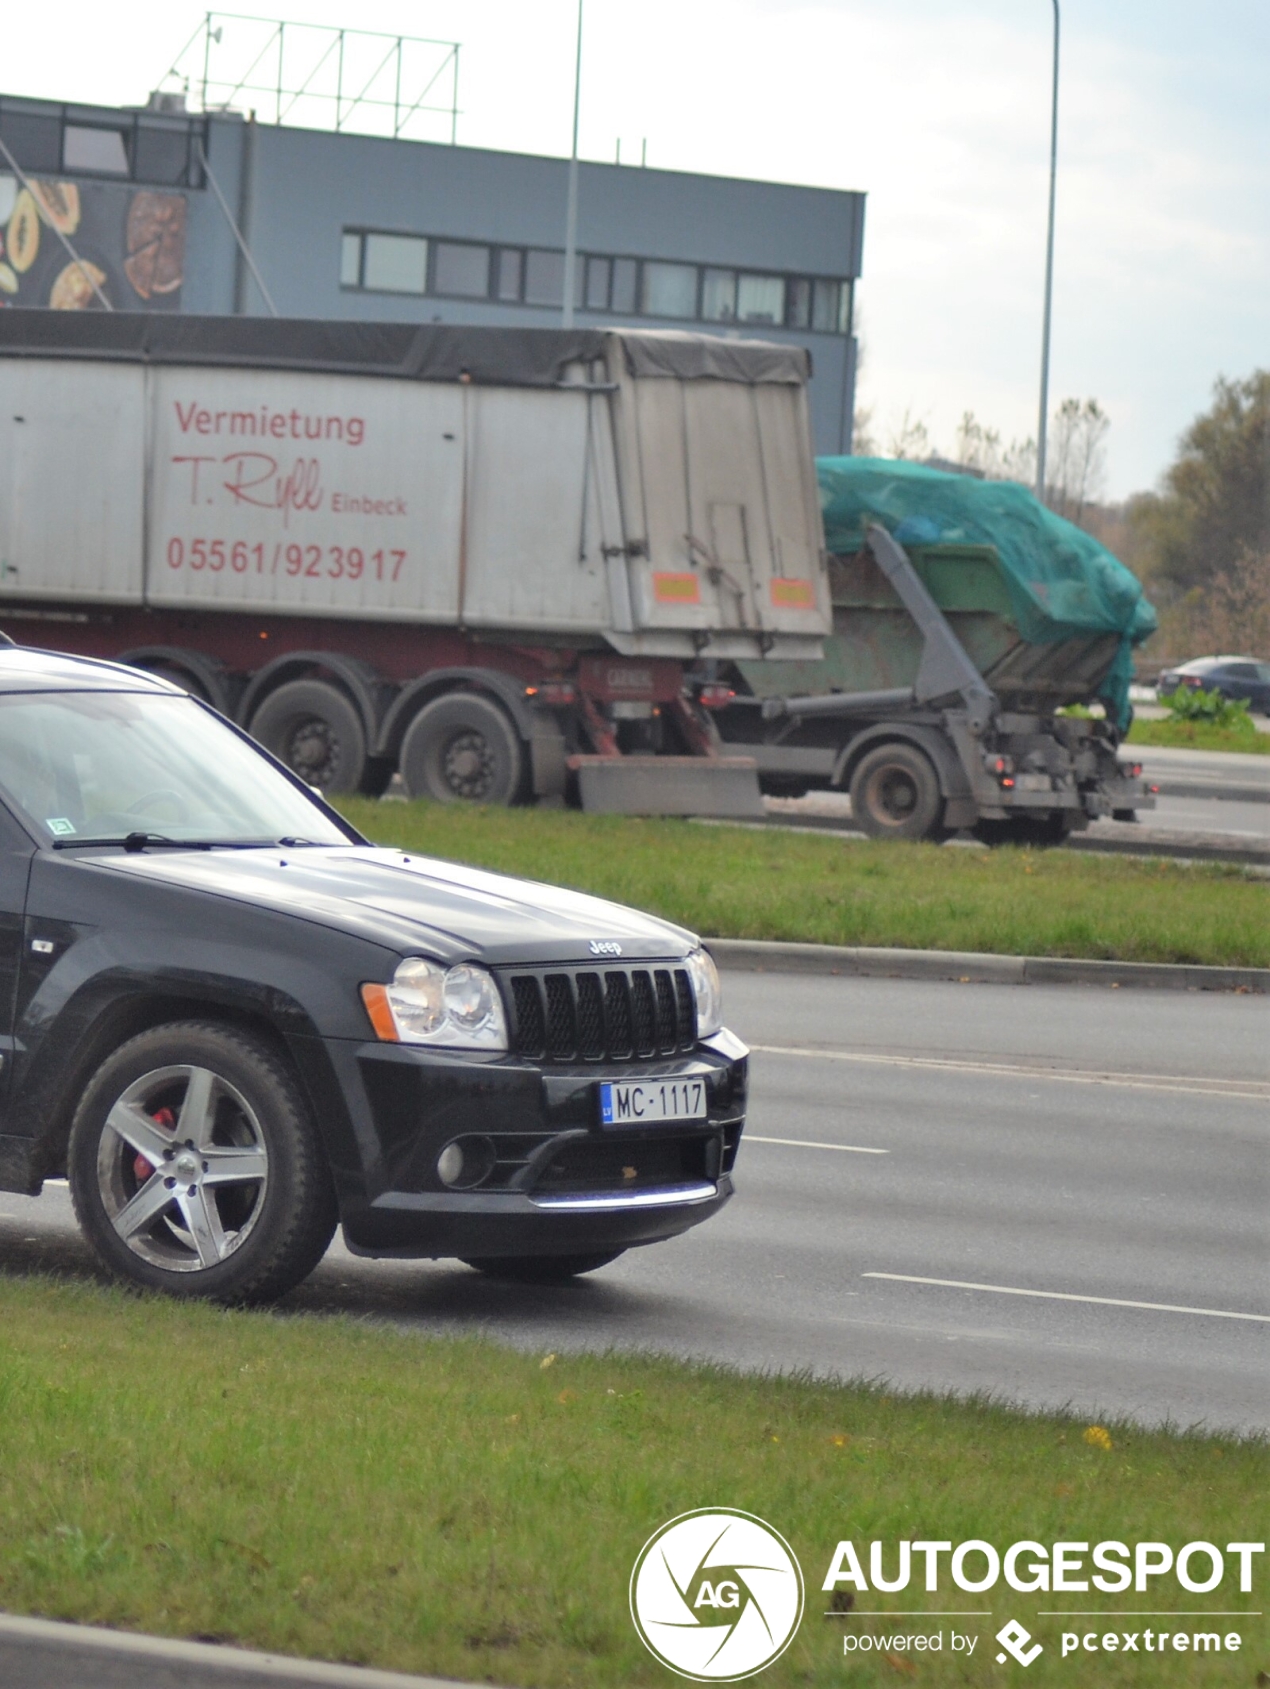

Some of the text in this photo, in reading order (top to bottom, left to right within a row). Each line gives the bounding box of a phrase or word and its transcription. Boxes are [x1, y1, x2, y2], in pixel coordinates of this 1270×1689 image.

[175, 401, 364, 446] Vermietung
[171, 453, 406, 529] T. Ryll Einbeck
[590, 940, 622, 956] Jeep
[617, 1084, 701, 1118] MC-1117
